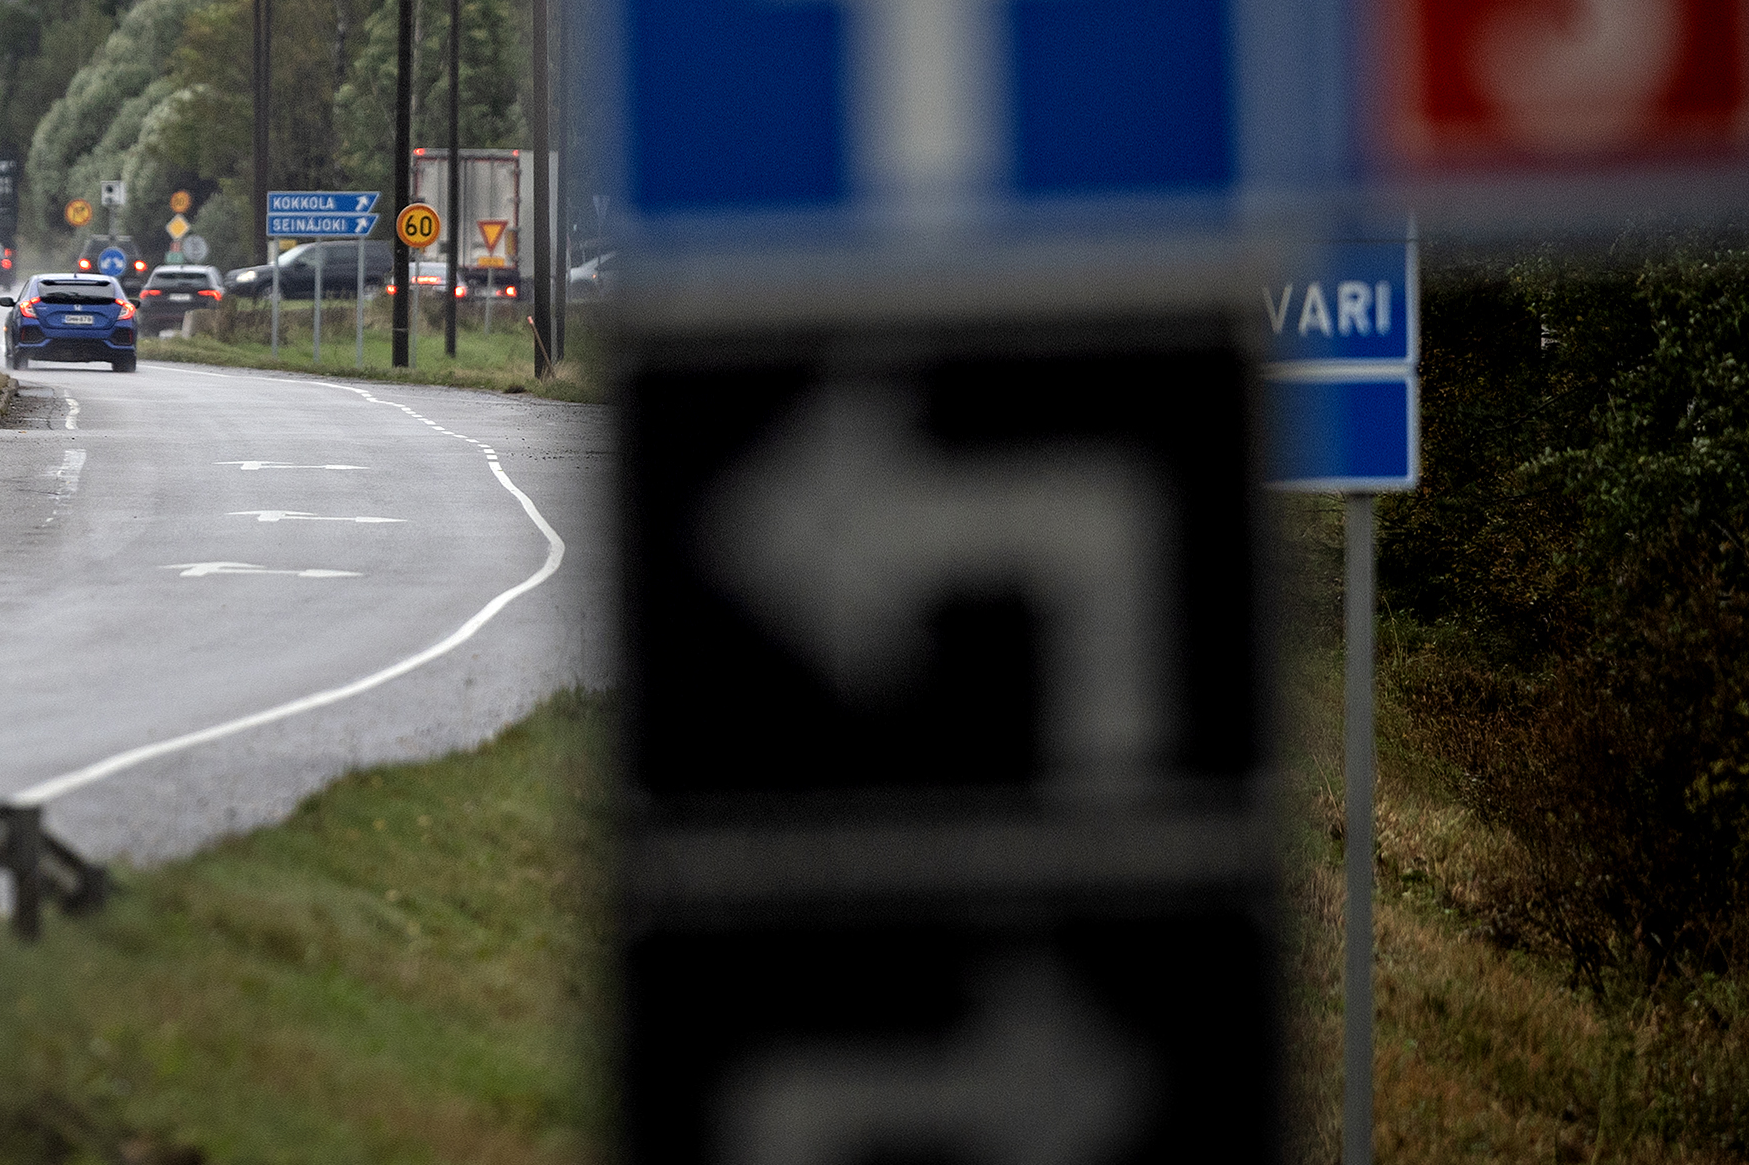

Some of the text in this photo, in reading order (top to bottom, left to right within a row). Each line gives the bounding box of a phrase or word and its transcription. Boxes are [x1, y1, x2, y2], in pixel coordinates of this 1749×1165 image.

[273, 196, 335, 210] KOKKOLA
[272, 217, 346, 232] SEINÄJOKI
[405, 215, 432, 237] 60
